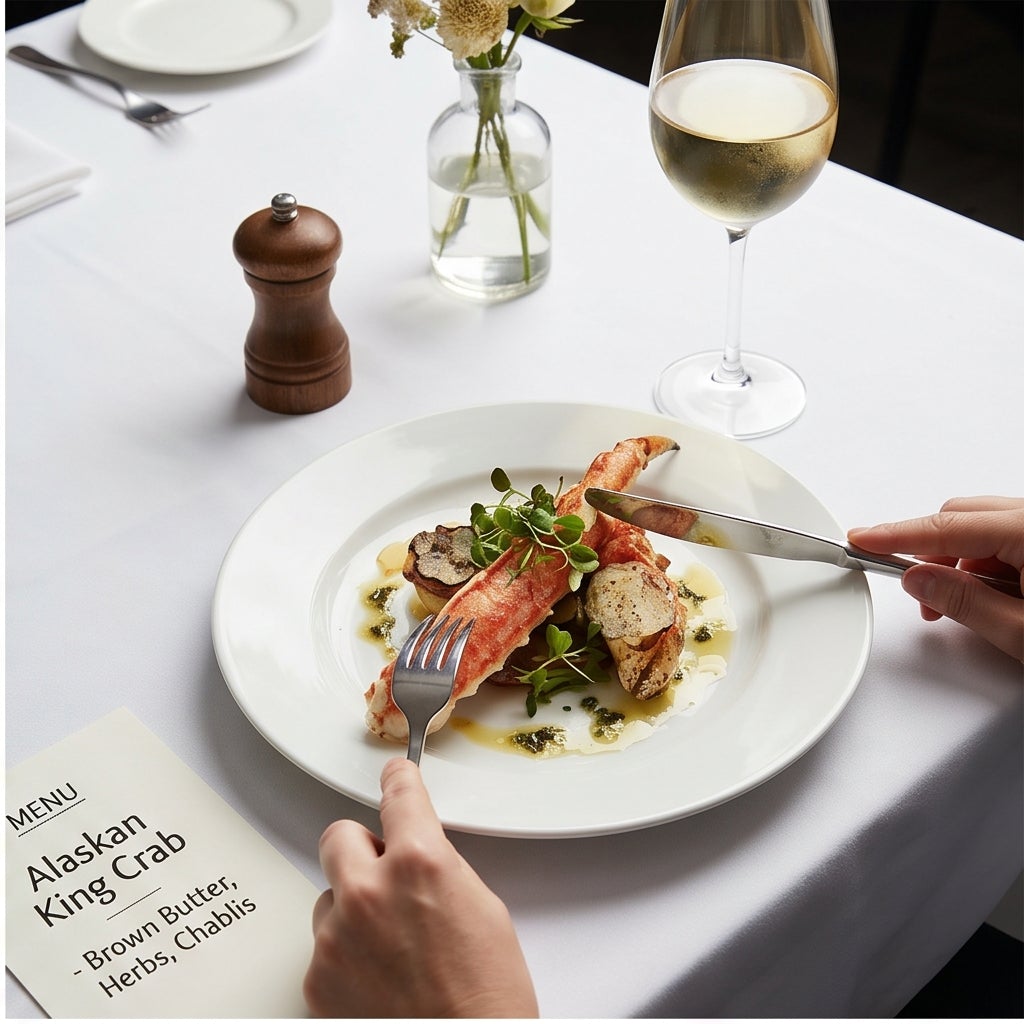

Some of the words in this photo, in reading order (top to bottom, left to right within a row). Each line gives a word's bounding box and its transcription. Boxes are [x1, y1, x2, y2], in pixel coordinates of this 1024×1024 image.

[5, 782, 78, 831] MENU
[26, 814, 148, 893] Alaskan
[33, 876, 117, 928] King
[111, 830, 186, 880] Crab
[82, 921, 161, 971] Brown
[157, 876, 238, 926] Butter,
[98, 951, 177, 999] Herbs,
[174, 898, 257, 950] Chablis
